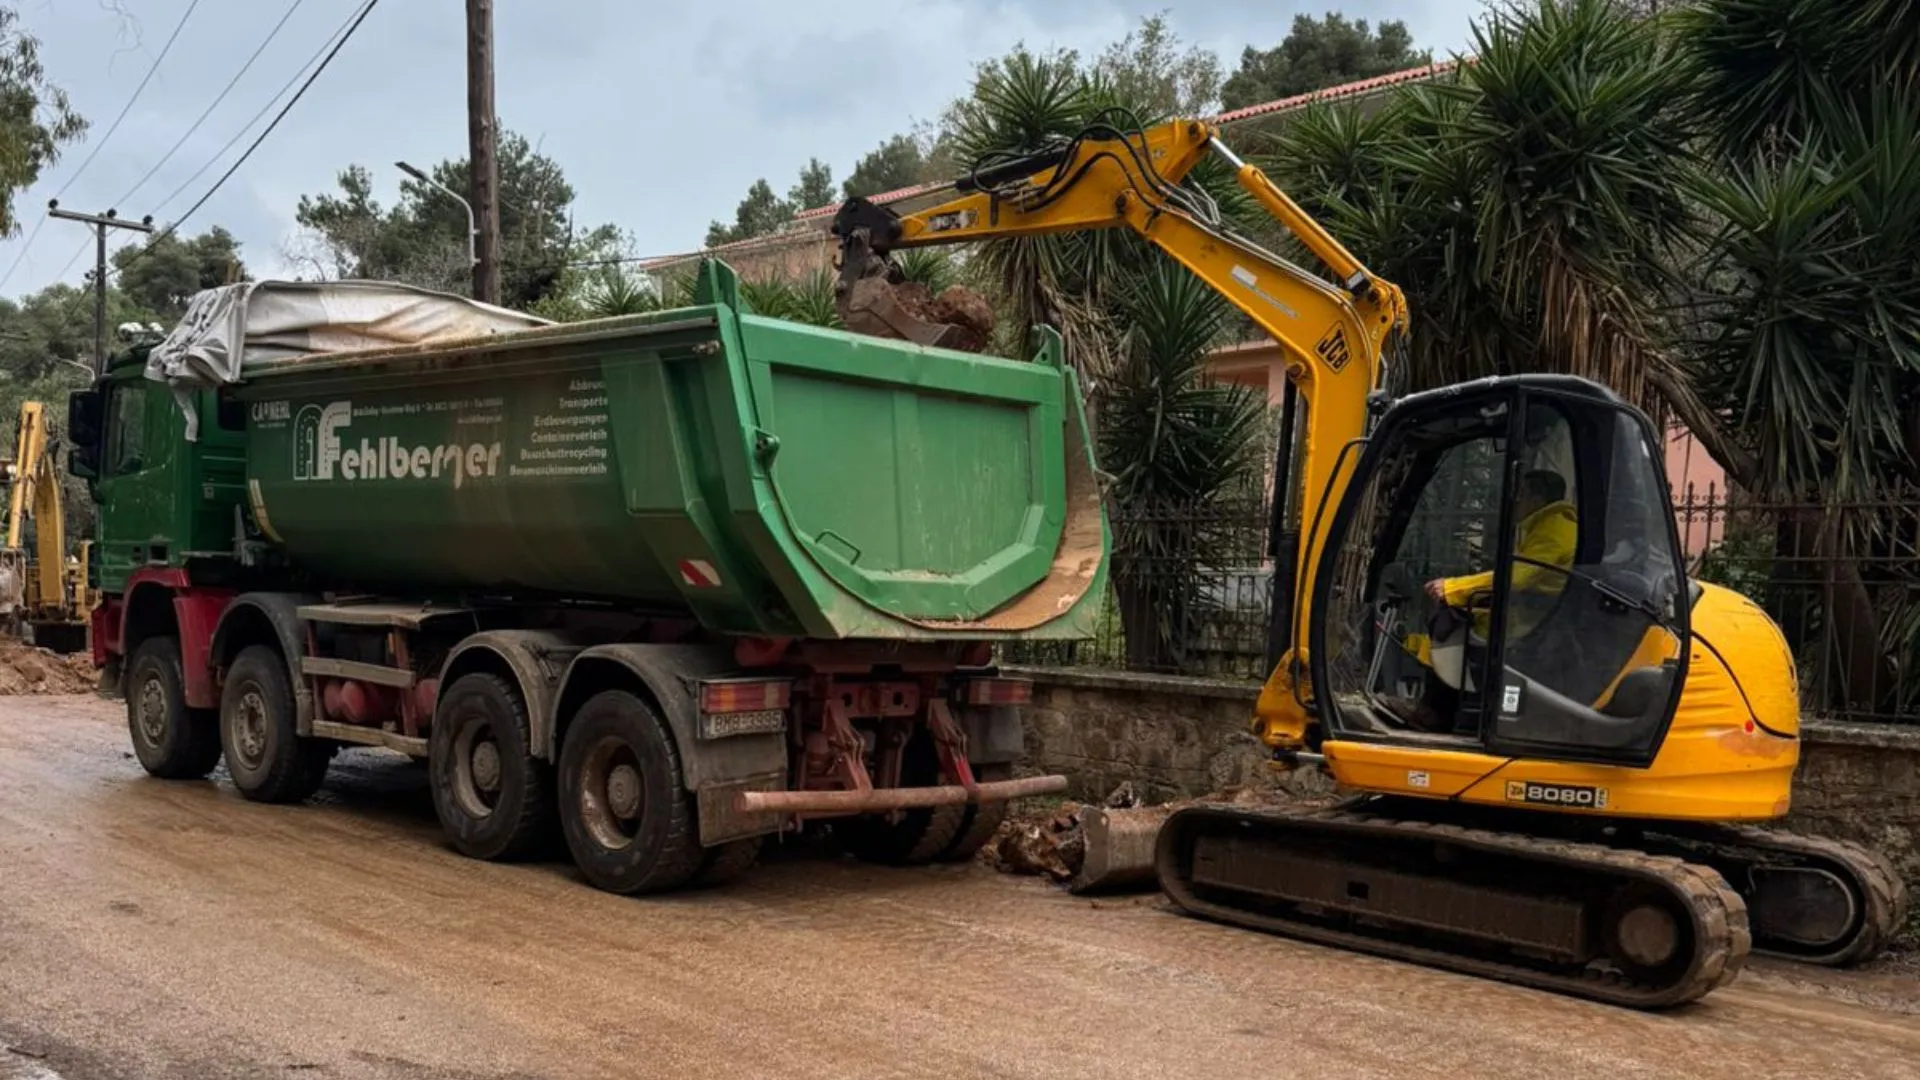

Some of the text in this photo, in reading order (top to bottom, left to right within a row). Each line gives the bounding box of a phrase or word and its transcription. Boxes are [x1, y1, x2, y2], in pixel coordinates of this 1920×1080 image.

[1317, 328, 1349, 370] JCB
[318, 400, 501, 489] Fehlberger
[1527, 785, 1593, 804] 8080
